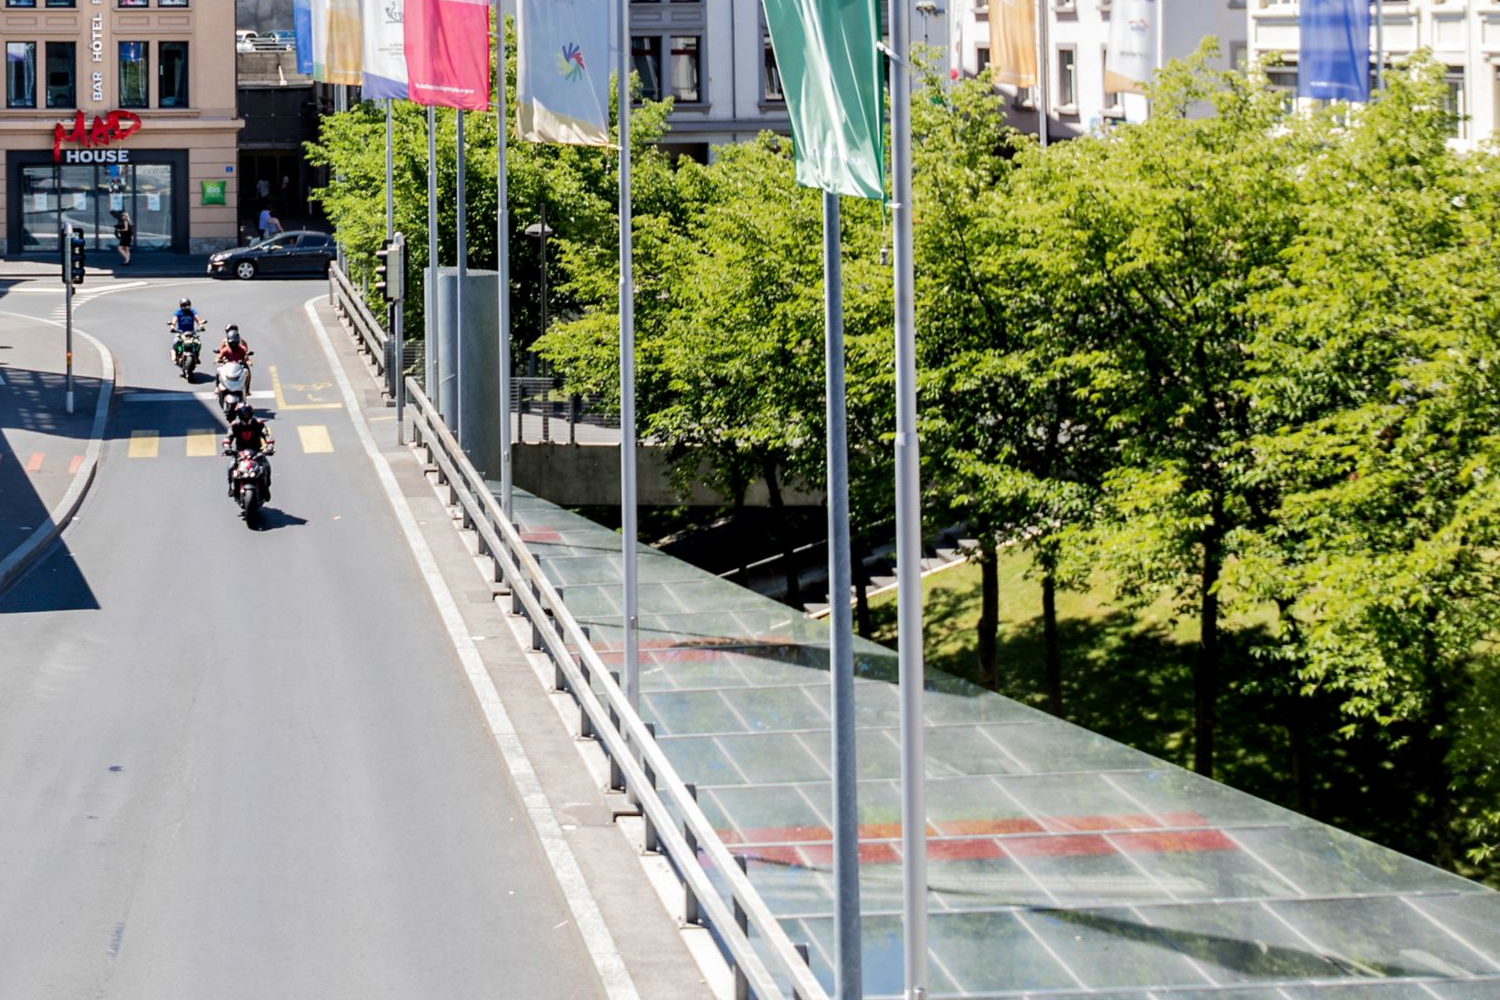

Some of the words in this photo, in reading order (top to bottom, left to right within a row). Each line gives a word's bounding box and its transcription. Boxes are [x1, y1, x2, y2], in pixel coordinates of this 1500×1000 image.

[89, 12, 103, 62] HÔTEL
[92, 71, 103, 101] BAR
[53, 108, 142, 165] MAD
[66, 149, 129, 163] HOUSE
